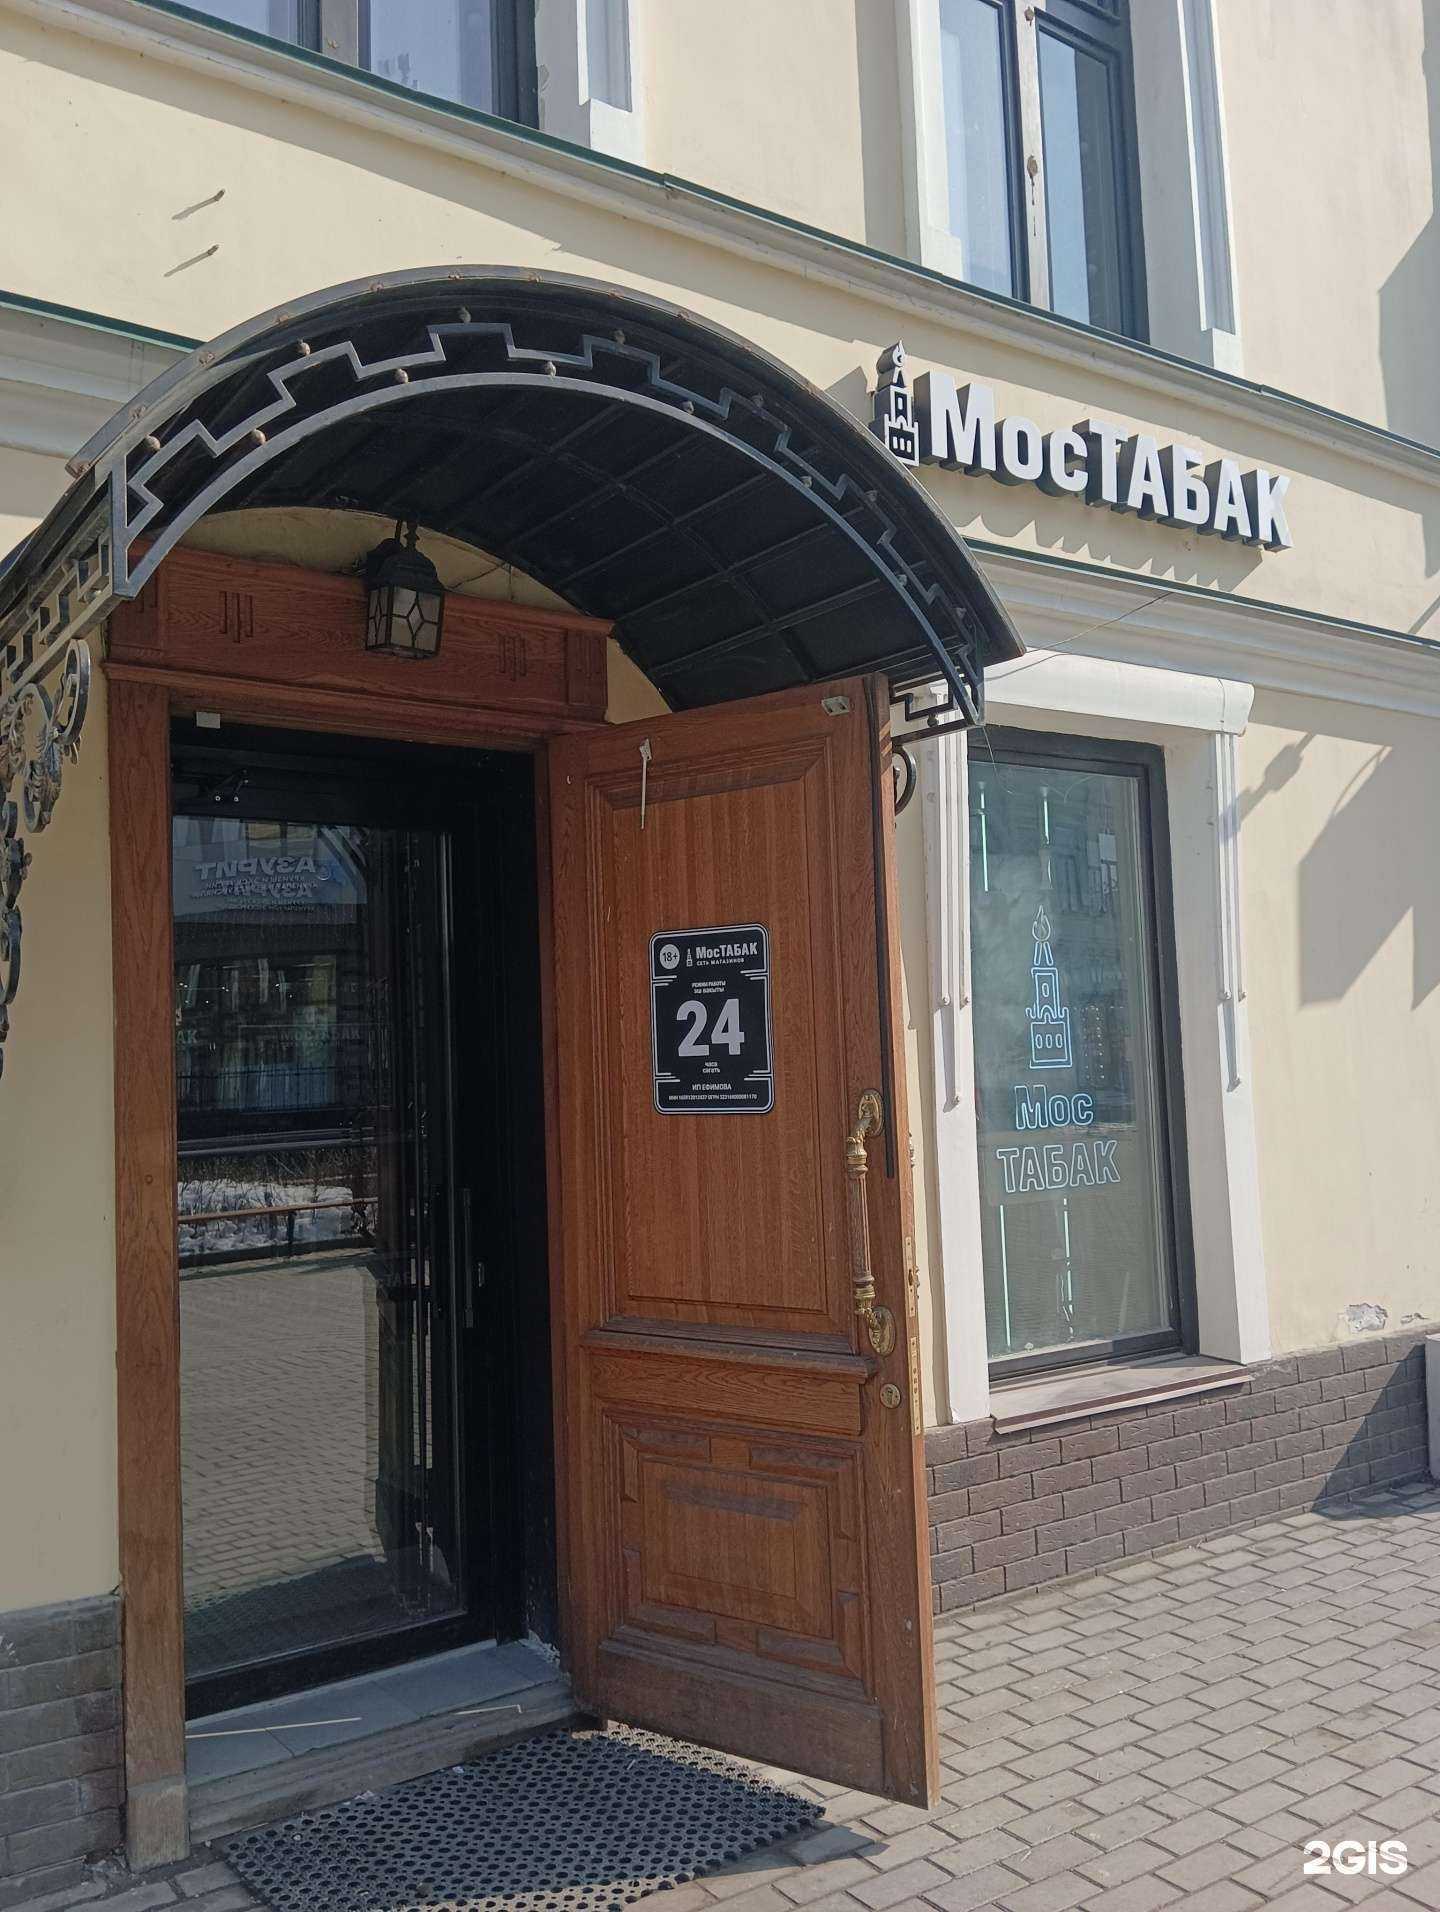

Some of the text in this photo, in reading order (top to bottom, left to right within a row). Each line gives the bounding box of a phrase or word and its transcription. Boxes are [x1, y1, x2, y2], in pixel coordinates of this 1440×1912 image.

[926, 371, 1294, 551] МосТАБАК
[661, 951, 678, 963] 18+
[676, 998, 745, 1057] 24
[1014, 1084, 1093, 1130] Мос
[996, 1139, 1121, 1194] ТАБАК
